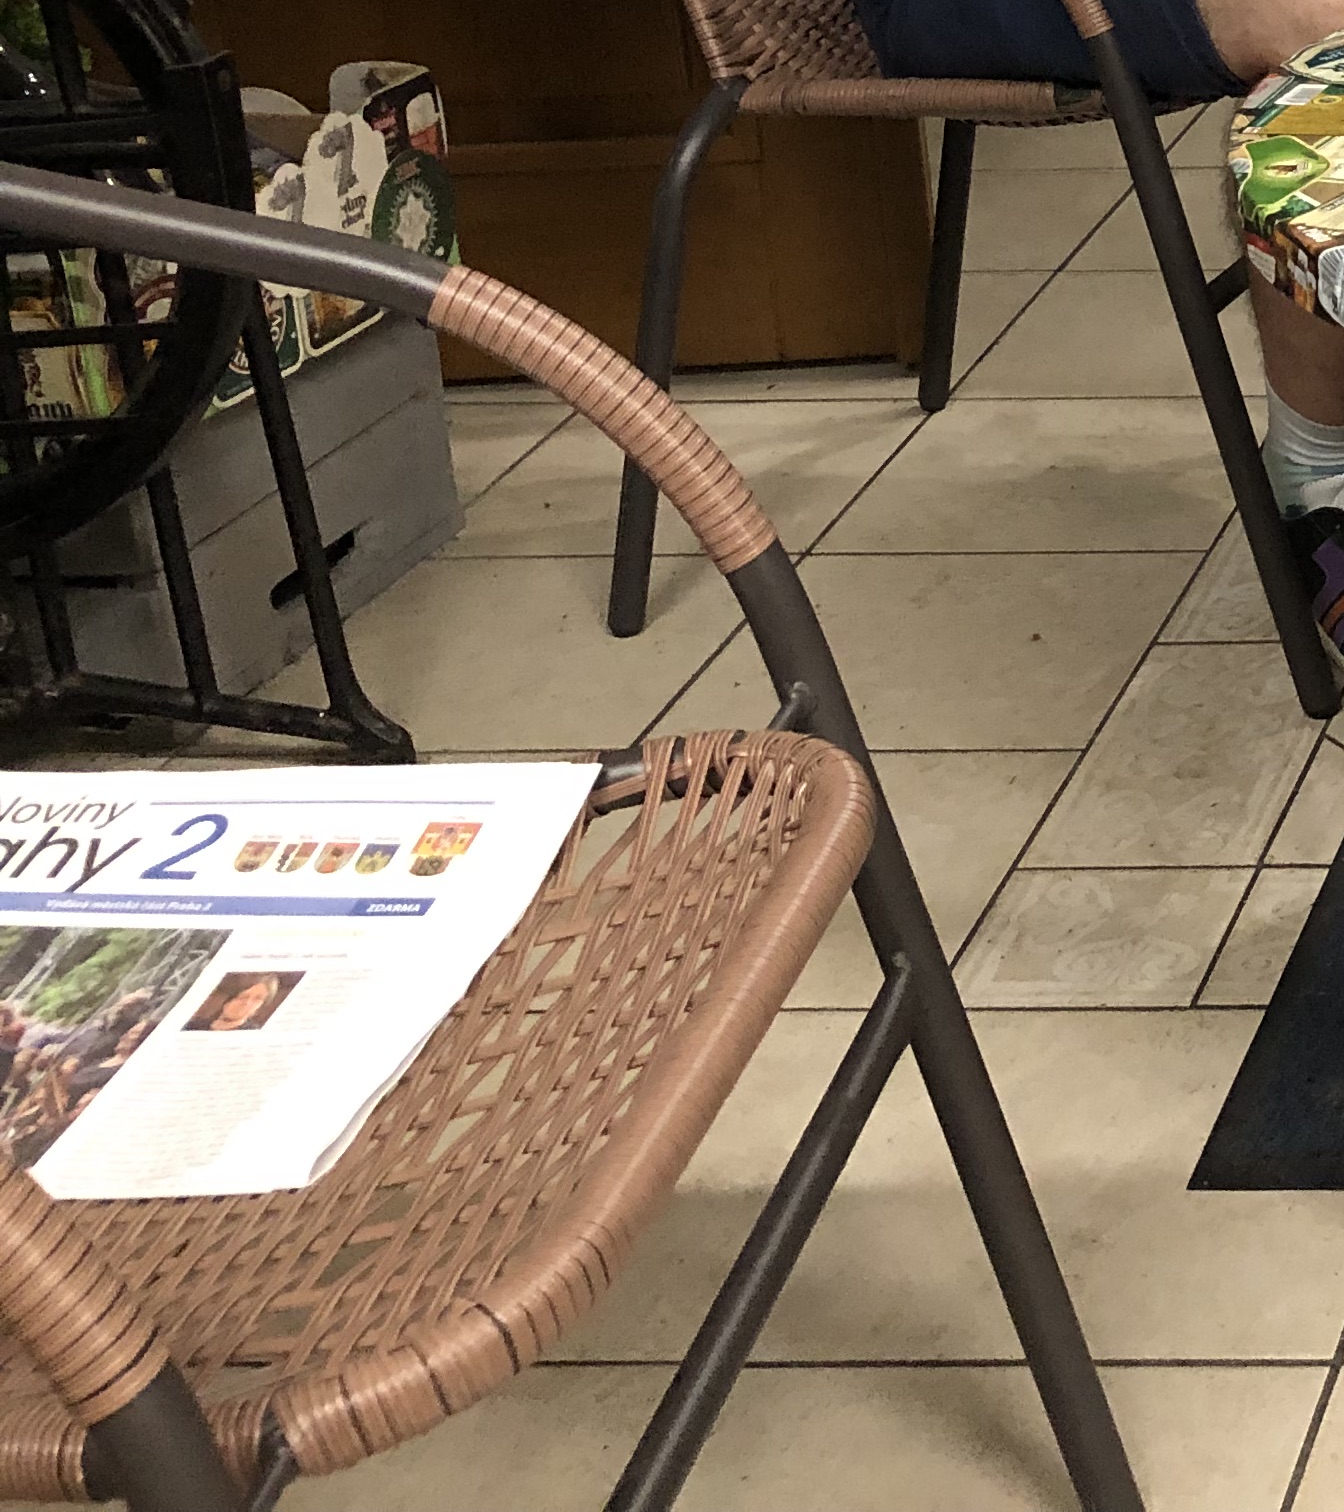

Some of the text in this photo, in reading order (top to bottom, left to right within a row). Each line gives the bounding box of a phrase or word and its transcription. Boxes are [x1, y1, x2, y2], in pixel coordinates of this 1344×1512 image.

[140, 813, 229, 881] 2
[167, 901, 201, 911] Praha
[366, 903, 422, 914] ZDARMA
